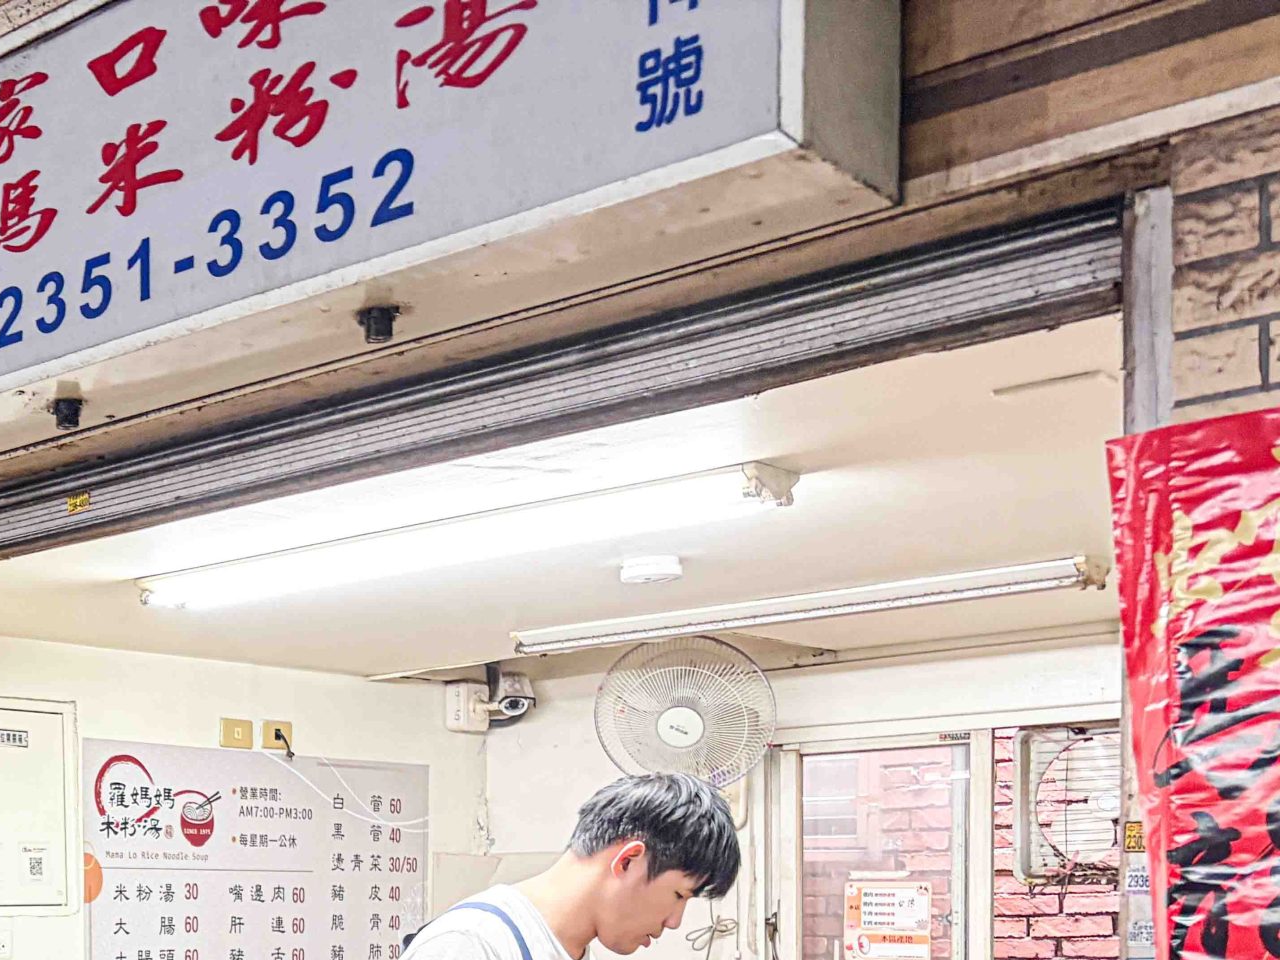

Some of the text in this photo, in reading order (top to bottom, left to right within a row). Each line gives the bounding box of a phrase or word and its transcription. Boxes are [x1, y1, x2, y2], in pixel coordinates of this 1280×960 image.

[109, 782, 175, 809] 羅媽媽
[332, 793, 402, 814] 白管 60
[238, 805, 313, 820] AM7:00-PM3:00
[99, 813, 163, 840] 米粉湯
[331, 823, 401, 844] 黑管 40
[239, 833, 297, 848] 每星期一公休
[105, 851, 209, 864] Mama Lo Rice Noodle Soup
[331, 853, 418, 873] 燙青菜 30/50
[113, 883, 199, 901] 米粉湯 30
[228, 884, 305, 904] 嘴邊肉 60
[331, 884, 401, 902] 豬皮 40
[113, 915, 199, 936] 大腸 60
[228, 915, 305, 935] 肝連 60
[331, 913, 401, 932] 脆骨 40
[389, 944, 401, 960] 30
